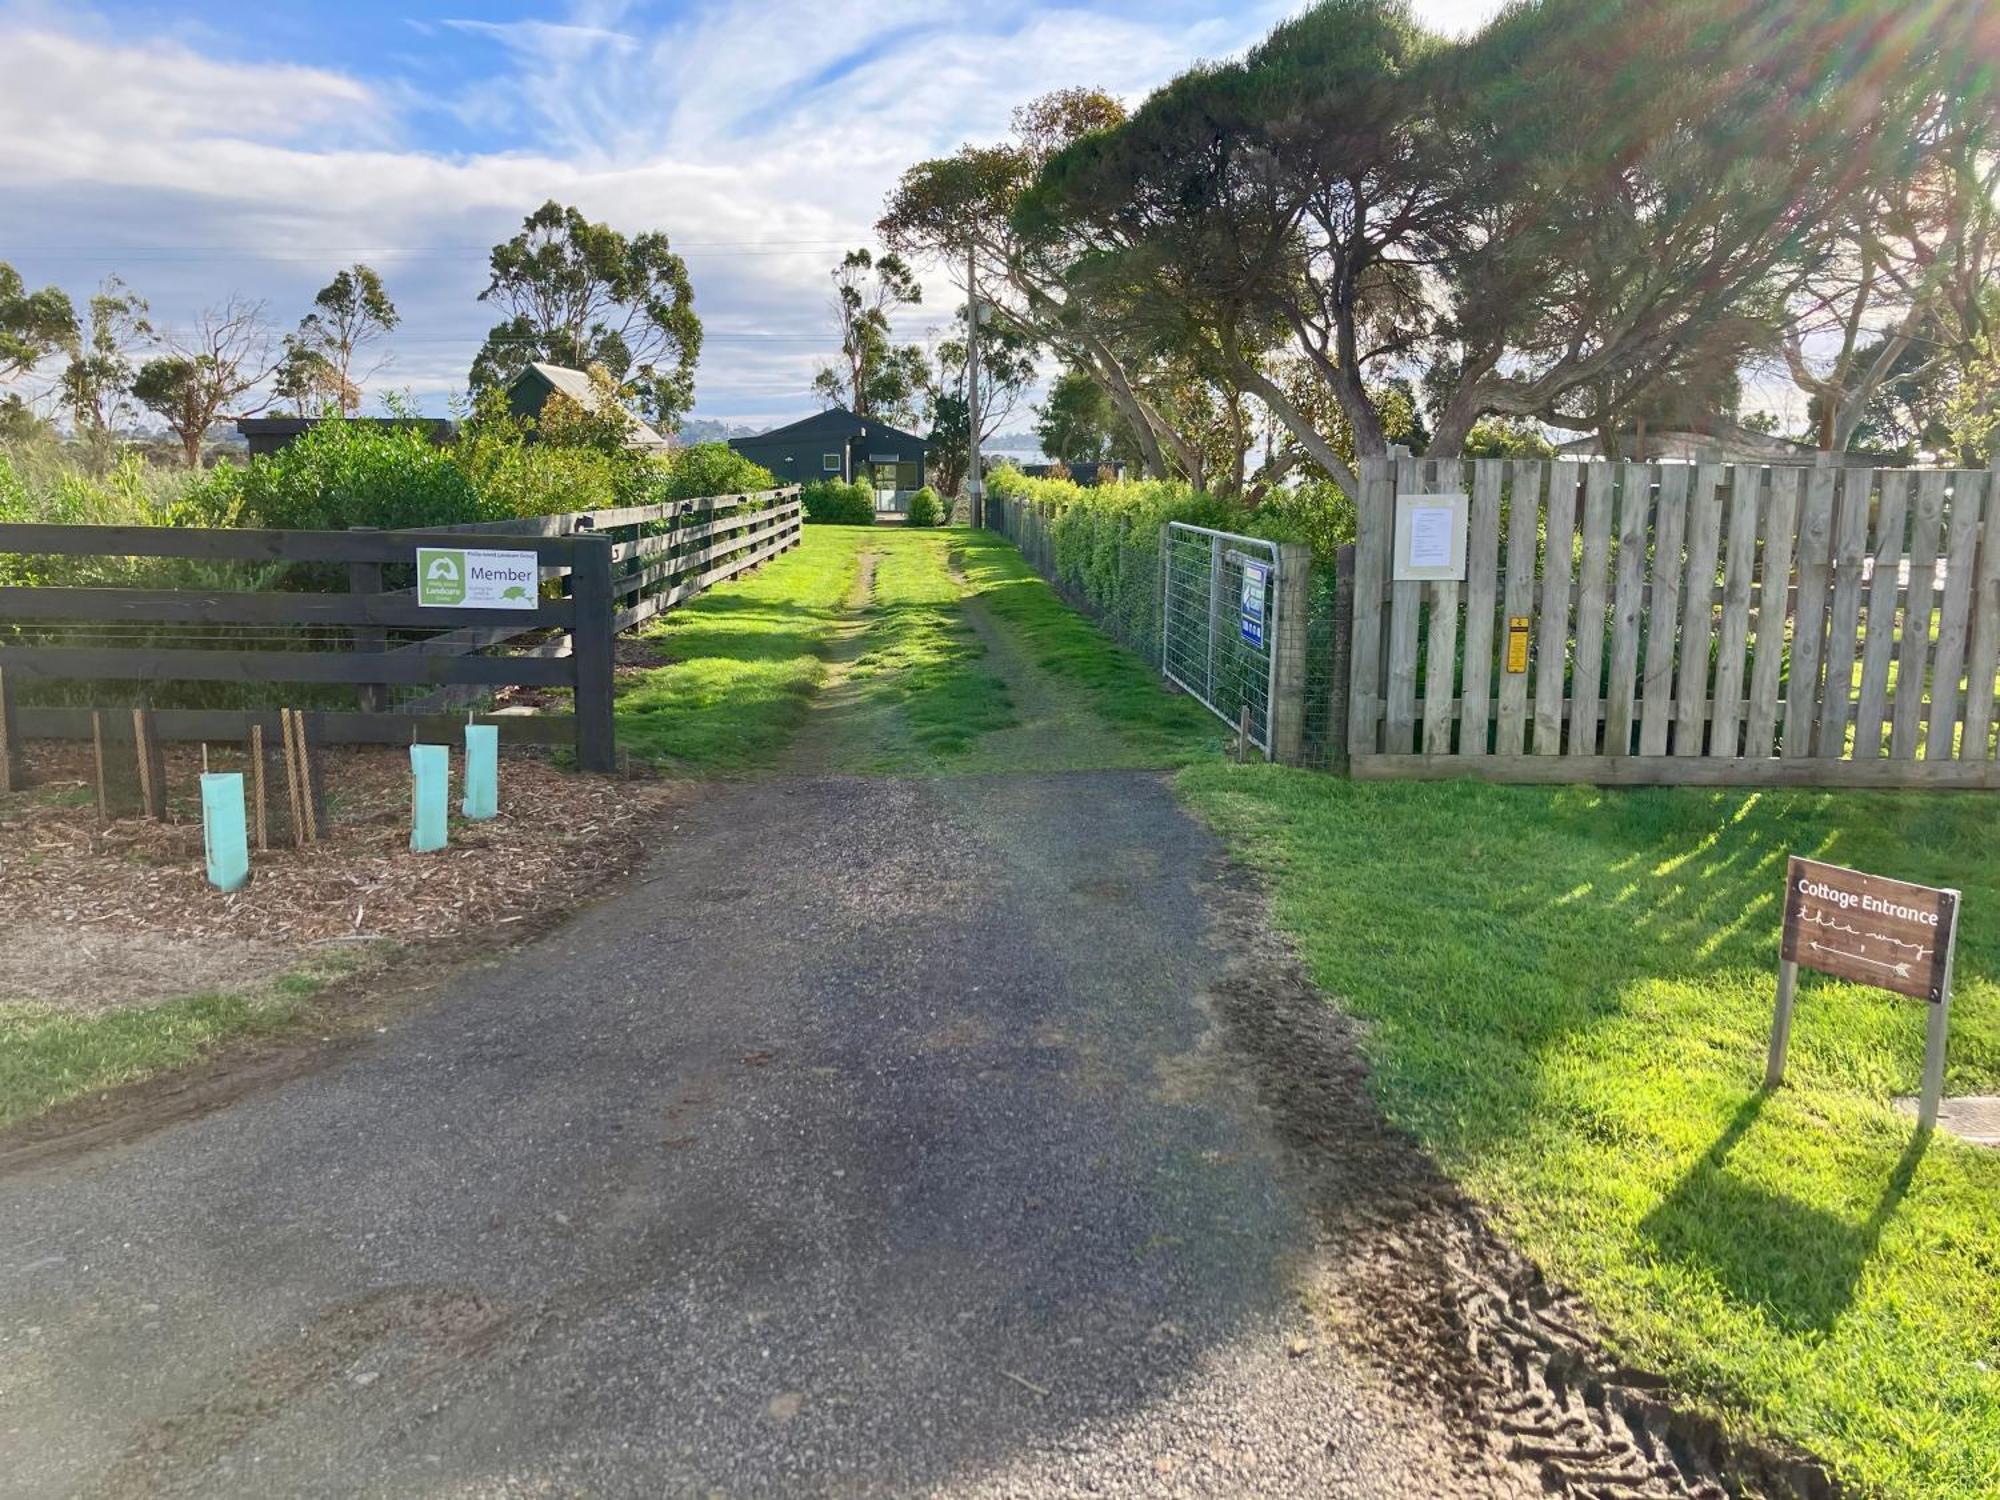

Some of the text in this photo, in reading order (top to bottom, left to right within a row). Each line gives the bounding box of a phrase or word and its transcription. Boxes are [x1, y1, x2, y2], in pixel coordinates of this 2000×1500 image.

[471, 567, 532, 582] Member
[426, 587, 461, 596] Landcare
[1798, 879, 1938, 926] Cottage Entrance
[1797, 905, 1934, 961] this way
